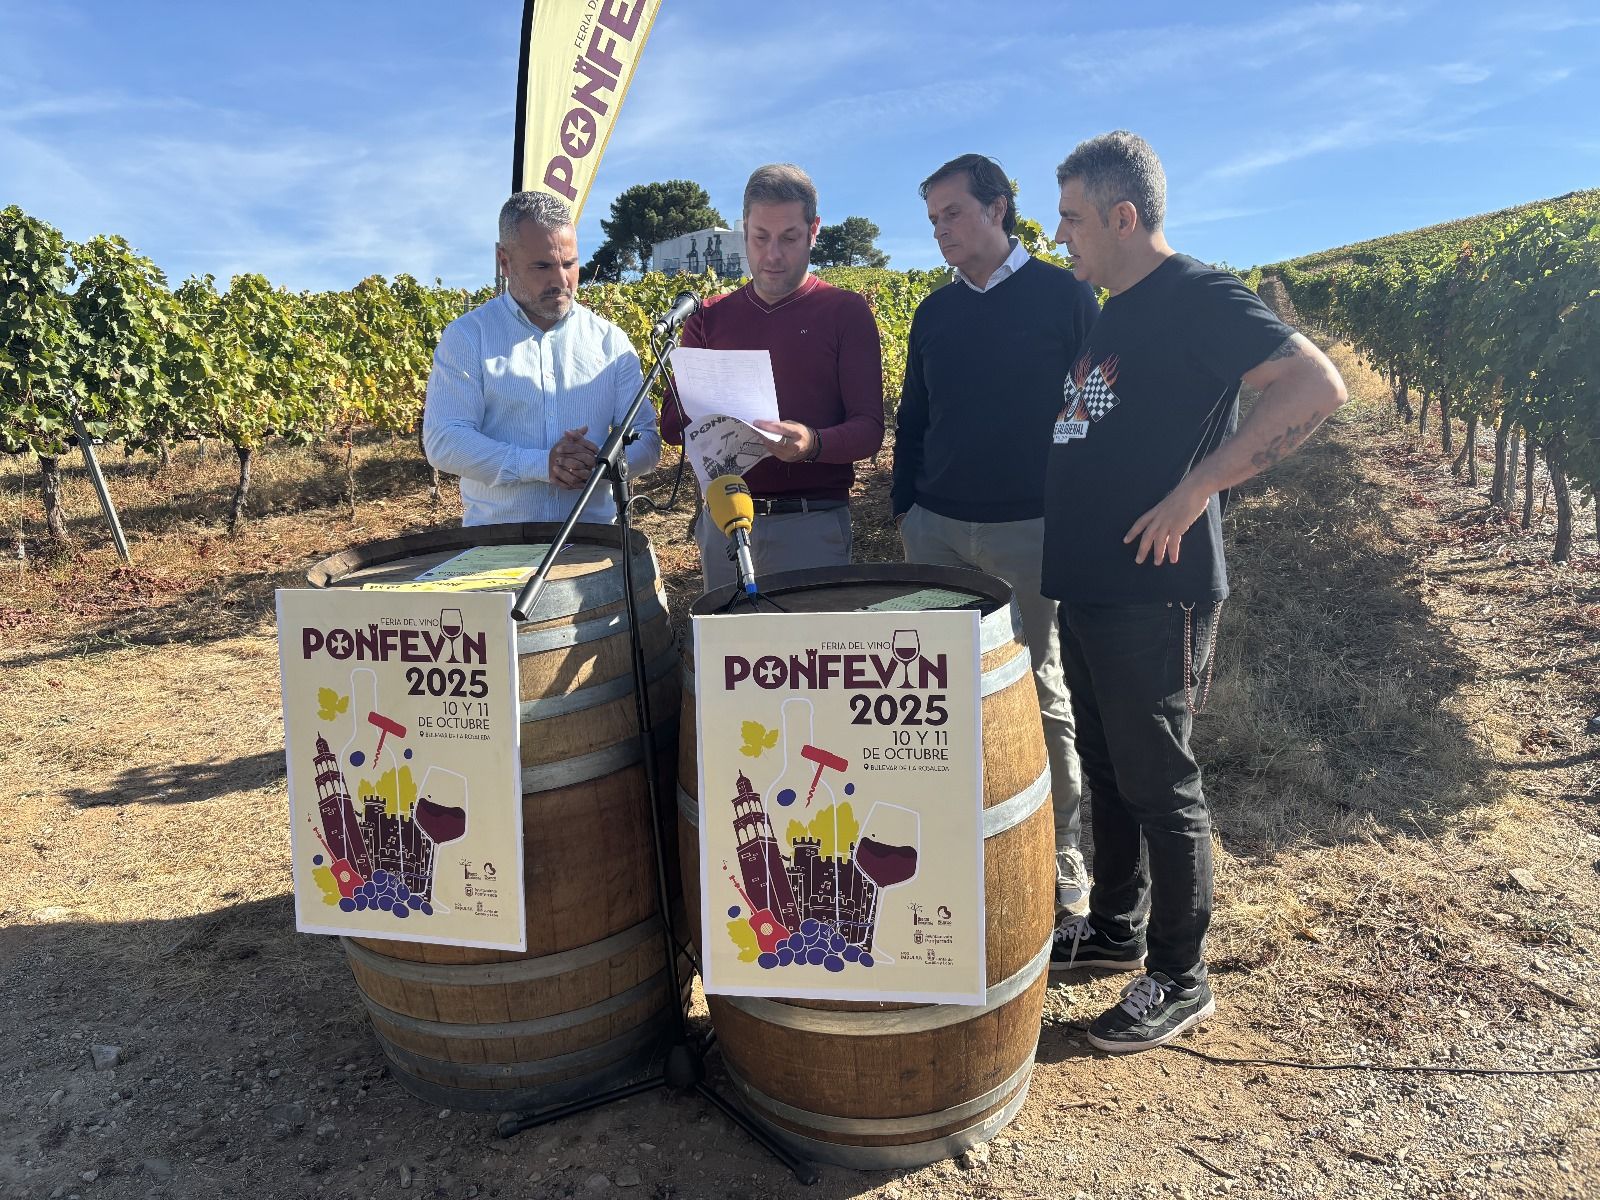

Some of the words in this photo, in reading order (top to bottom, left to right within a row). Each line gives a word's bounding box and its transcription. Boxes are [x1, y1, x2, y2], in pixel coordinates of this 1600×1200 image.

[574, 13, 594, 49] FERIA
[380, 617, 402, 627] FERIA
[403, 618, 418, 627] DEL
[419, 618, 440, 627] VINO
[302, 610, 488, 665] PONFEVIN
[821, 641, 847, 651] FERIA
[848, 641, 865, 650] DEL
[867, 641, 891, 650] VINO
[724, 632, 948, 691] PONFEVIN
[405, 666, 489, 699] 2025
[442, 701, 458, 716] 10
[462, 702, 472, 717] Y
[478, 702, 489, 717] 11
[849, 694, 949, 726] 2025
[418, 716, 433, 729] DE
[436, 716, 490, 730] OCTUBRE
[892, 730, 911, 746] 10
[915, 730, 929, 746] Y
[934, 730, 948, 746] 11
[863, 747, 881, 760] DE
[884, 747, 949, 761] OCTUBRE
